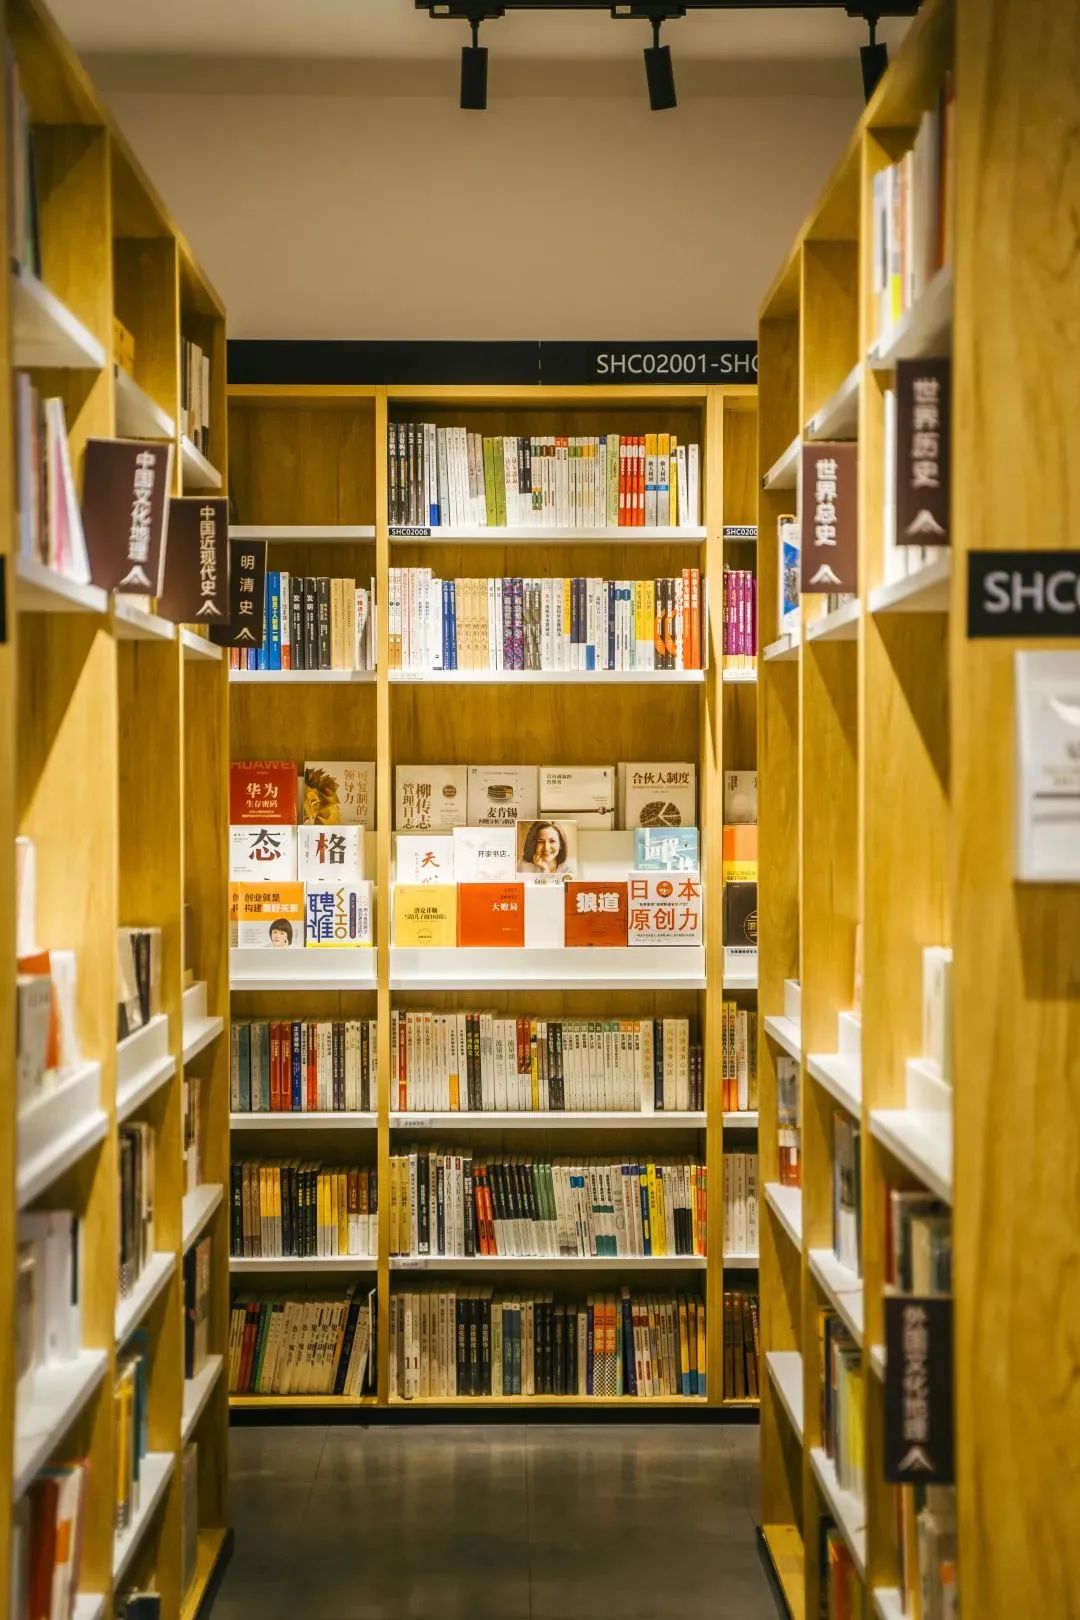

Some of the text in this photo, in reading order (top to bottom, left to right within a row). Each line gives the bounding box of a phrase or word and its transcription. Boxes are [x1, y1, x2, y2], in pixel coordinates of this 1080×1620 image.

[391, 528, 428, 536] SHC02006
[199, 505, 217, 597] 中国近现代史
[239, 555, 255, 615] 明清史
[983, 570, 1080, 614] SHC
[344, 769, 355, 804] 领导力
[632, 772, 690, 785] 合伙人制度
[245, 782, 279, 799] 华为
[356, 769, 368, 816] 可复制的
[246, 800, 278, 809] 生存密码
[402, 783, 414, 829] 管理日志
[416, 783, 431, 829] 柳传志
[487, 807, 518, 818] 麦肯锡
[245, 892, 281, 902] 创业就是
[492, 903, 519, 911] 大败局
[576, 892, 620, 913] 狼道
[245, 903, 299, 913] 构建美好关系
[629, 908, 699, 931] 原创力
